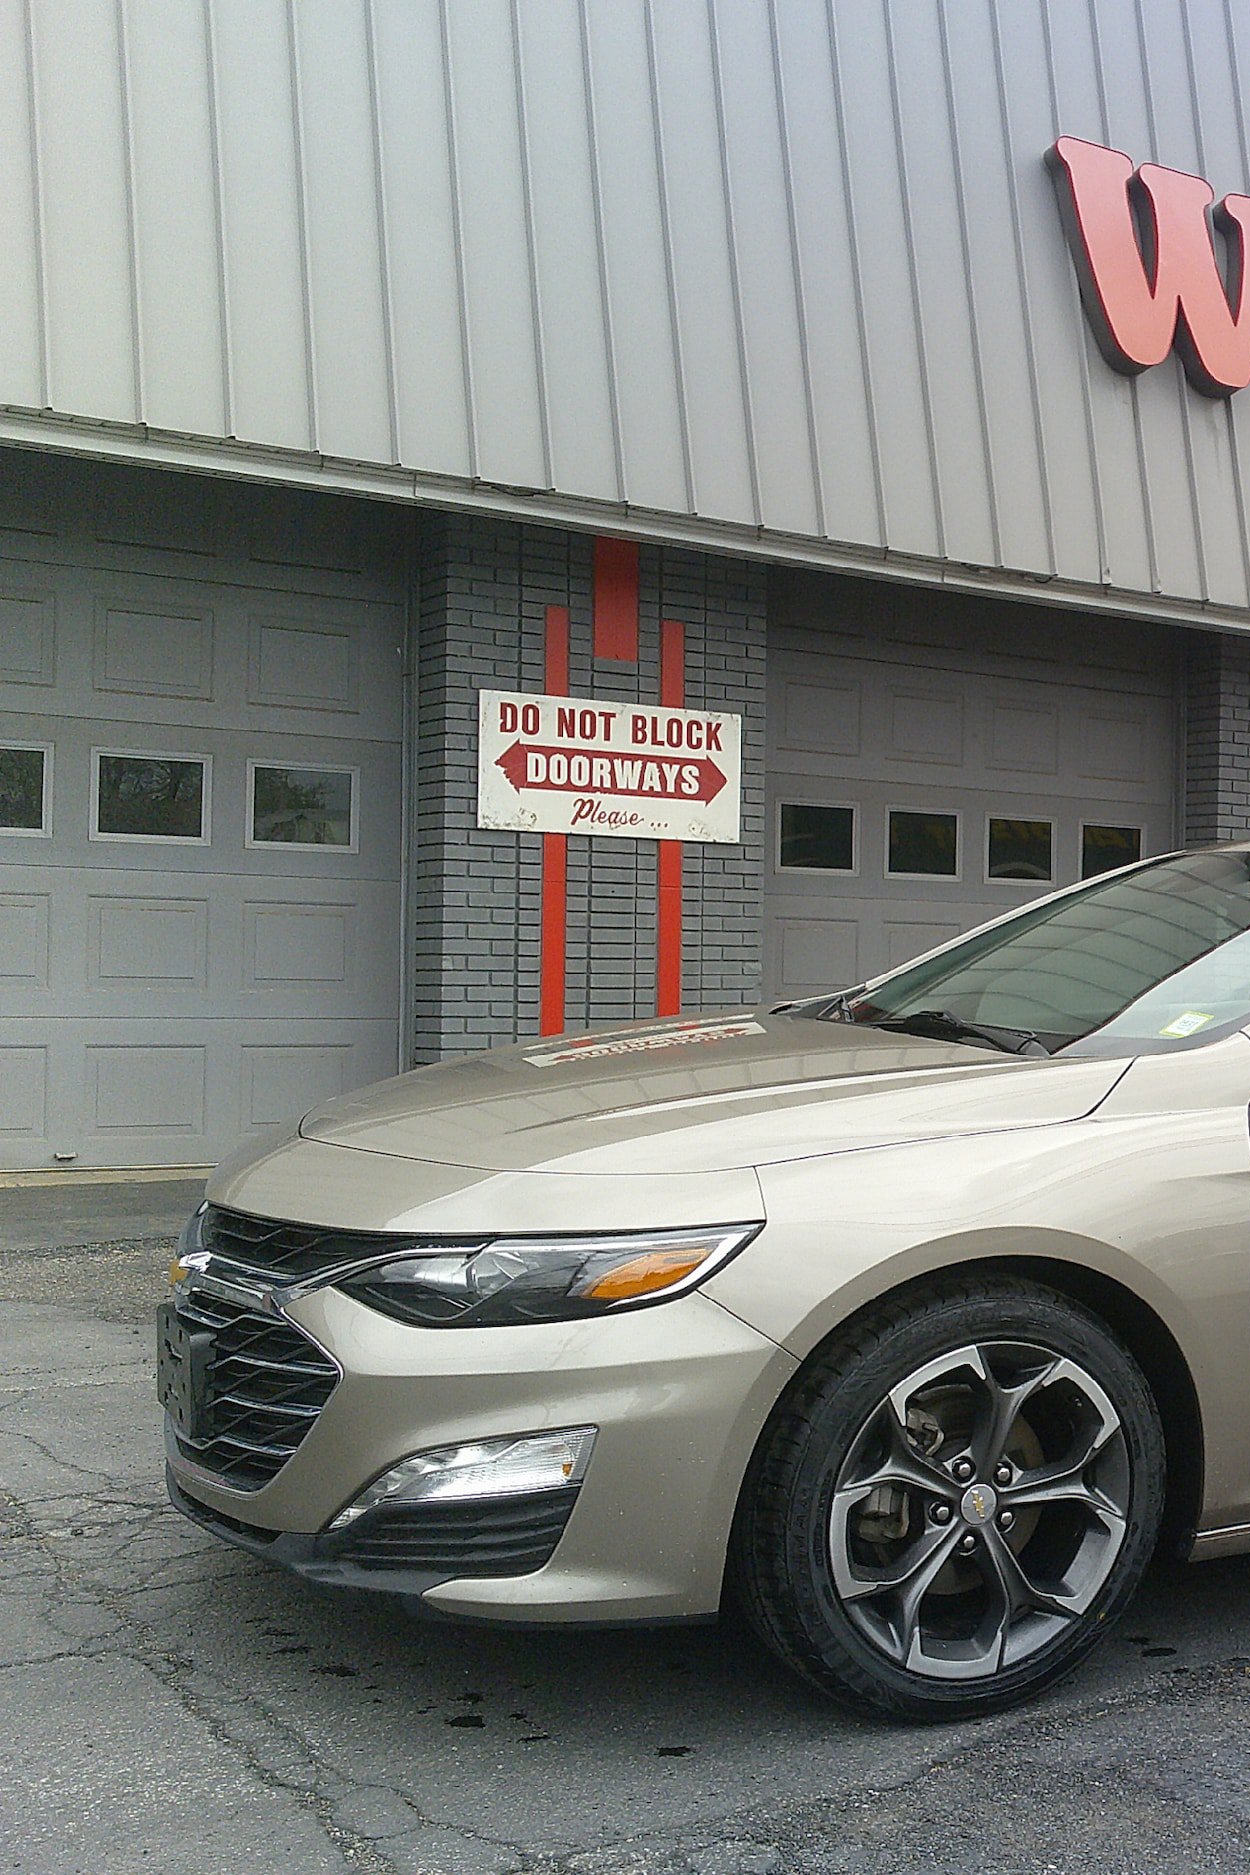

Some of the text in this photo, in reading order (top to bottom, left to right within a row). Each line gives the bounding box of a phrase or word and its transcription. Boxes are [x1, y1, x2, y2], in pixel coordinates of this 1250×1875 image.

[500, 702, 722, 752] DO NOT BLOCK
[526, 751, 700, 795] DOORWAYS
[570, 798, 643, 826] Please
